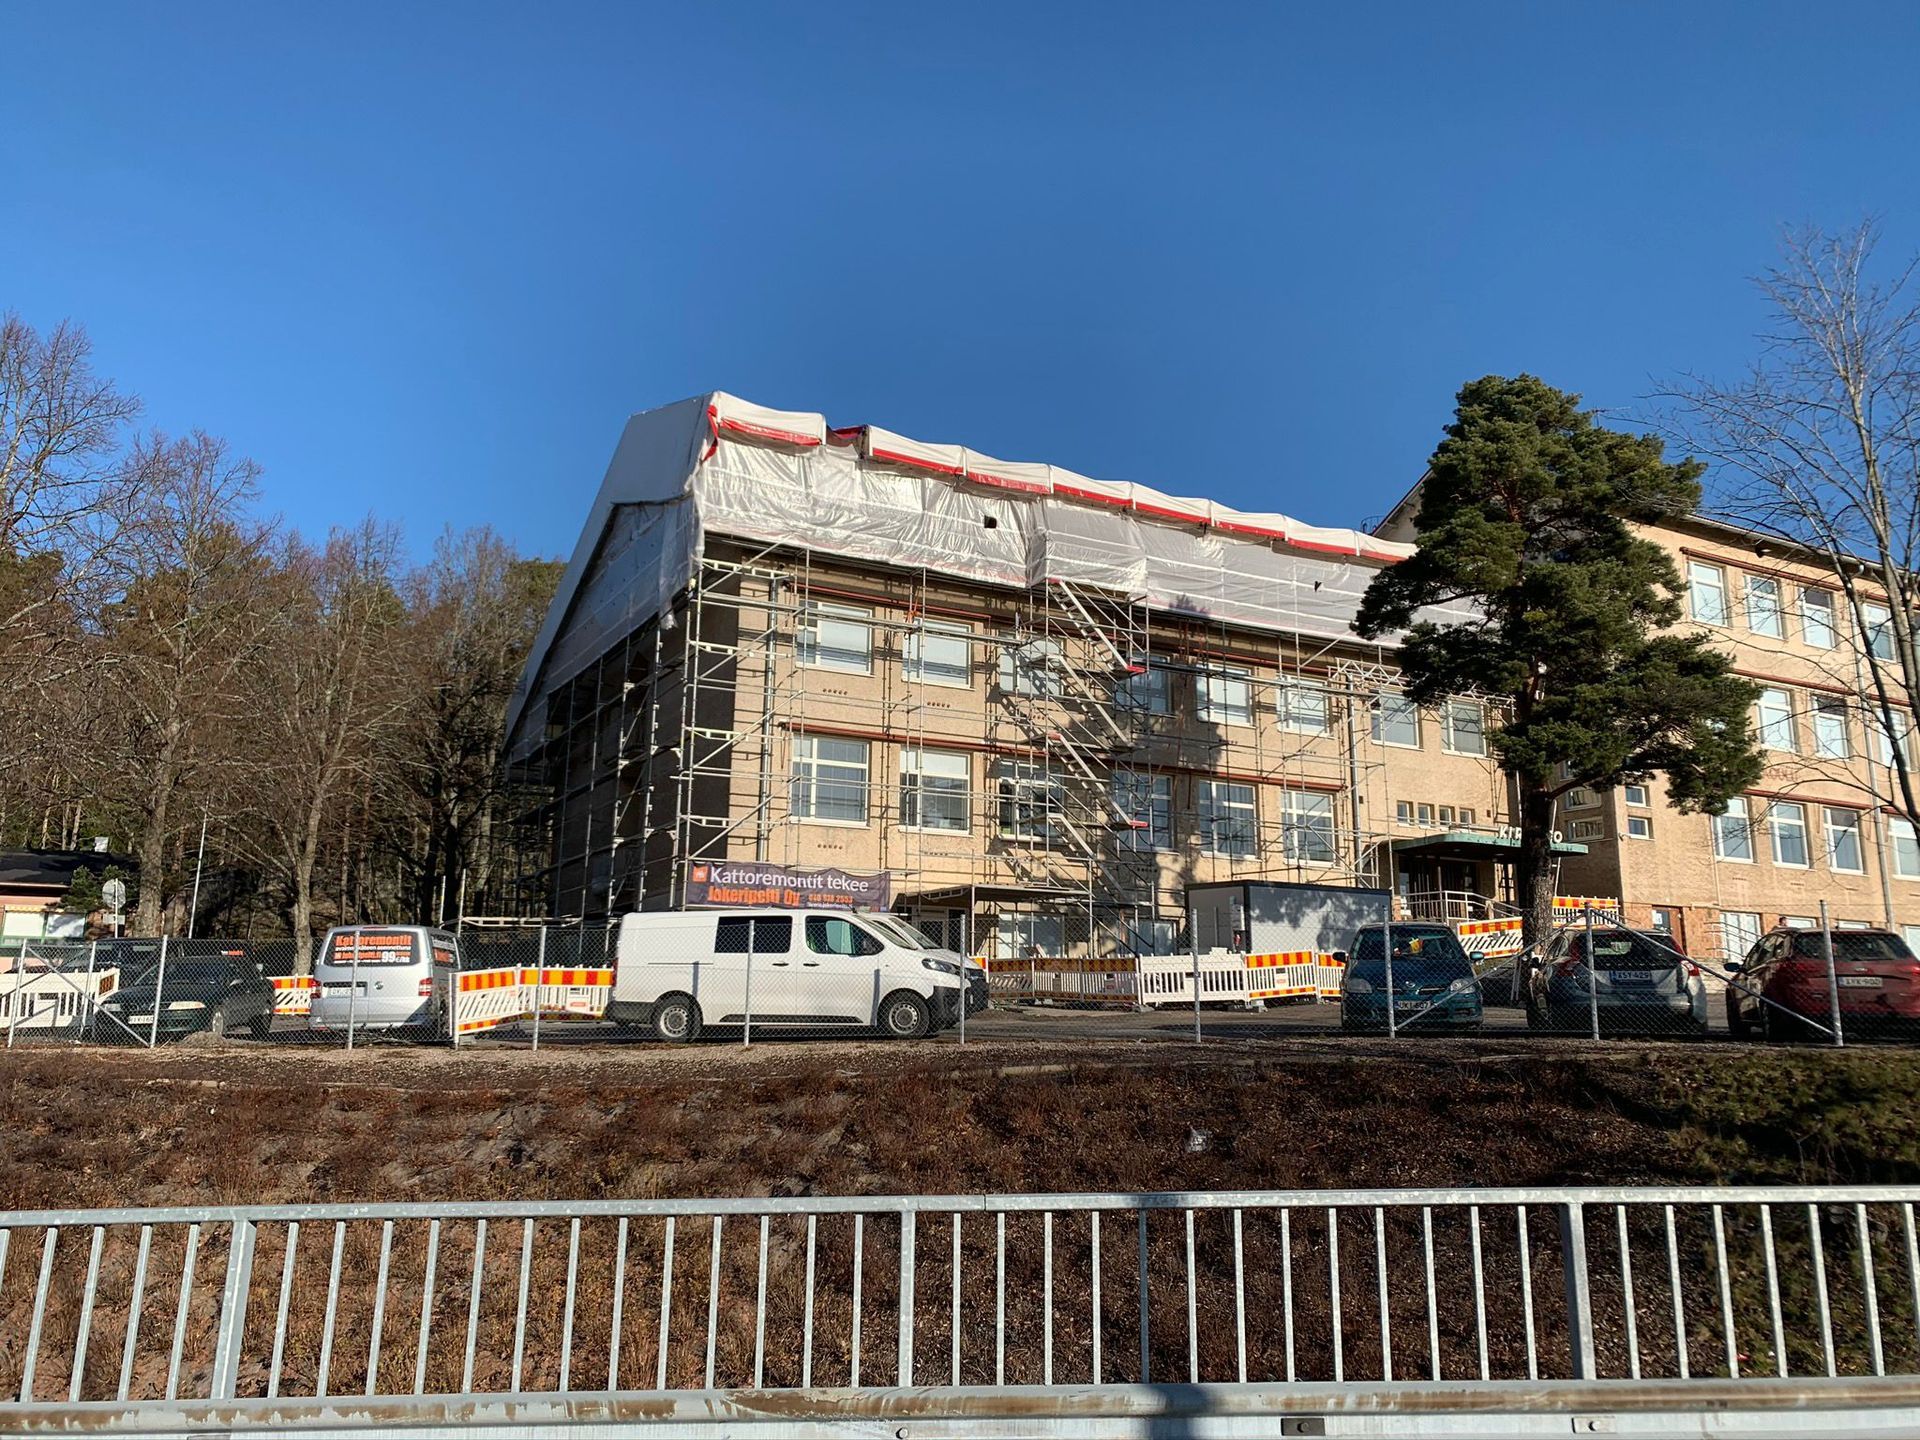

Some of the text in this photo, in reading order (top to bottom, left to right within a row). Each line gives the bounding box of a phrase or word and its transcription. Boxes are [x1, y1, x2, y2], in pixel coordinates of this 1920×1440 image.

[710, 866, 869, 892] Kattoremontit tekee
[783, 889, 801, 907] Oy
[335, 935, 412, 946] Katoremontit
[381, 951, 396, 963] 99
